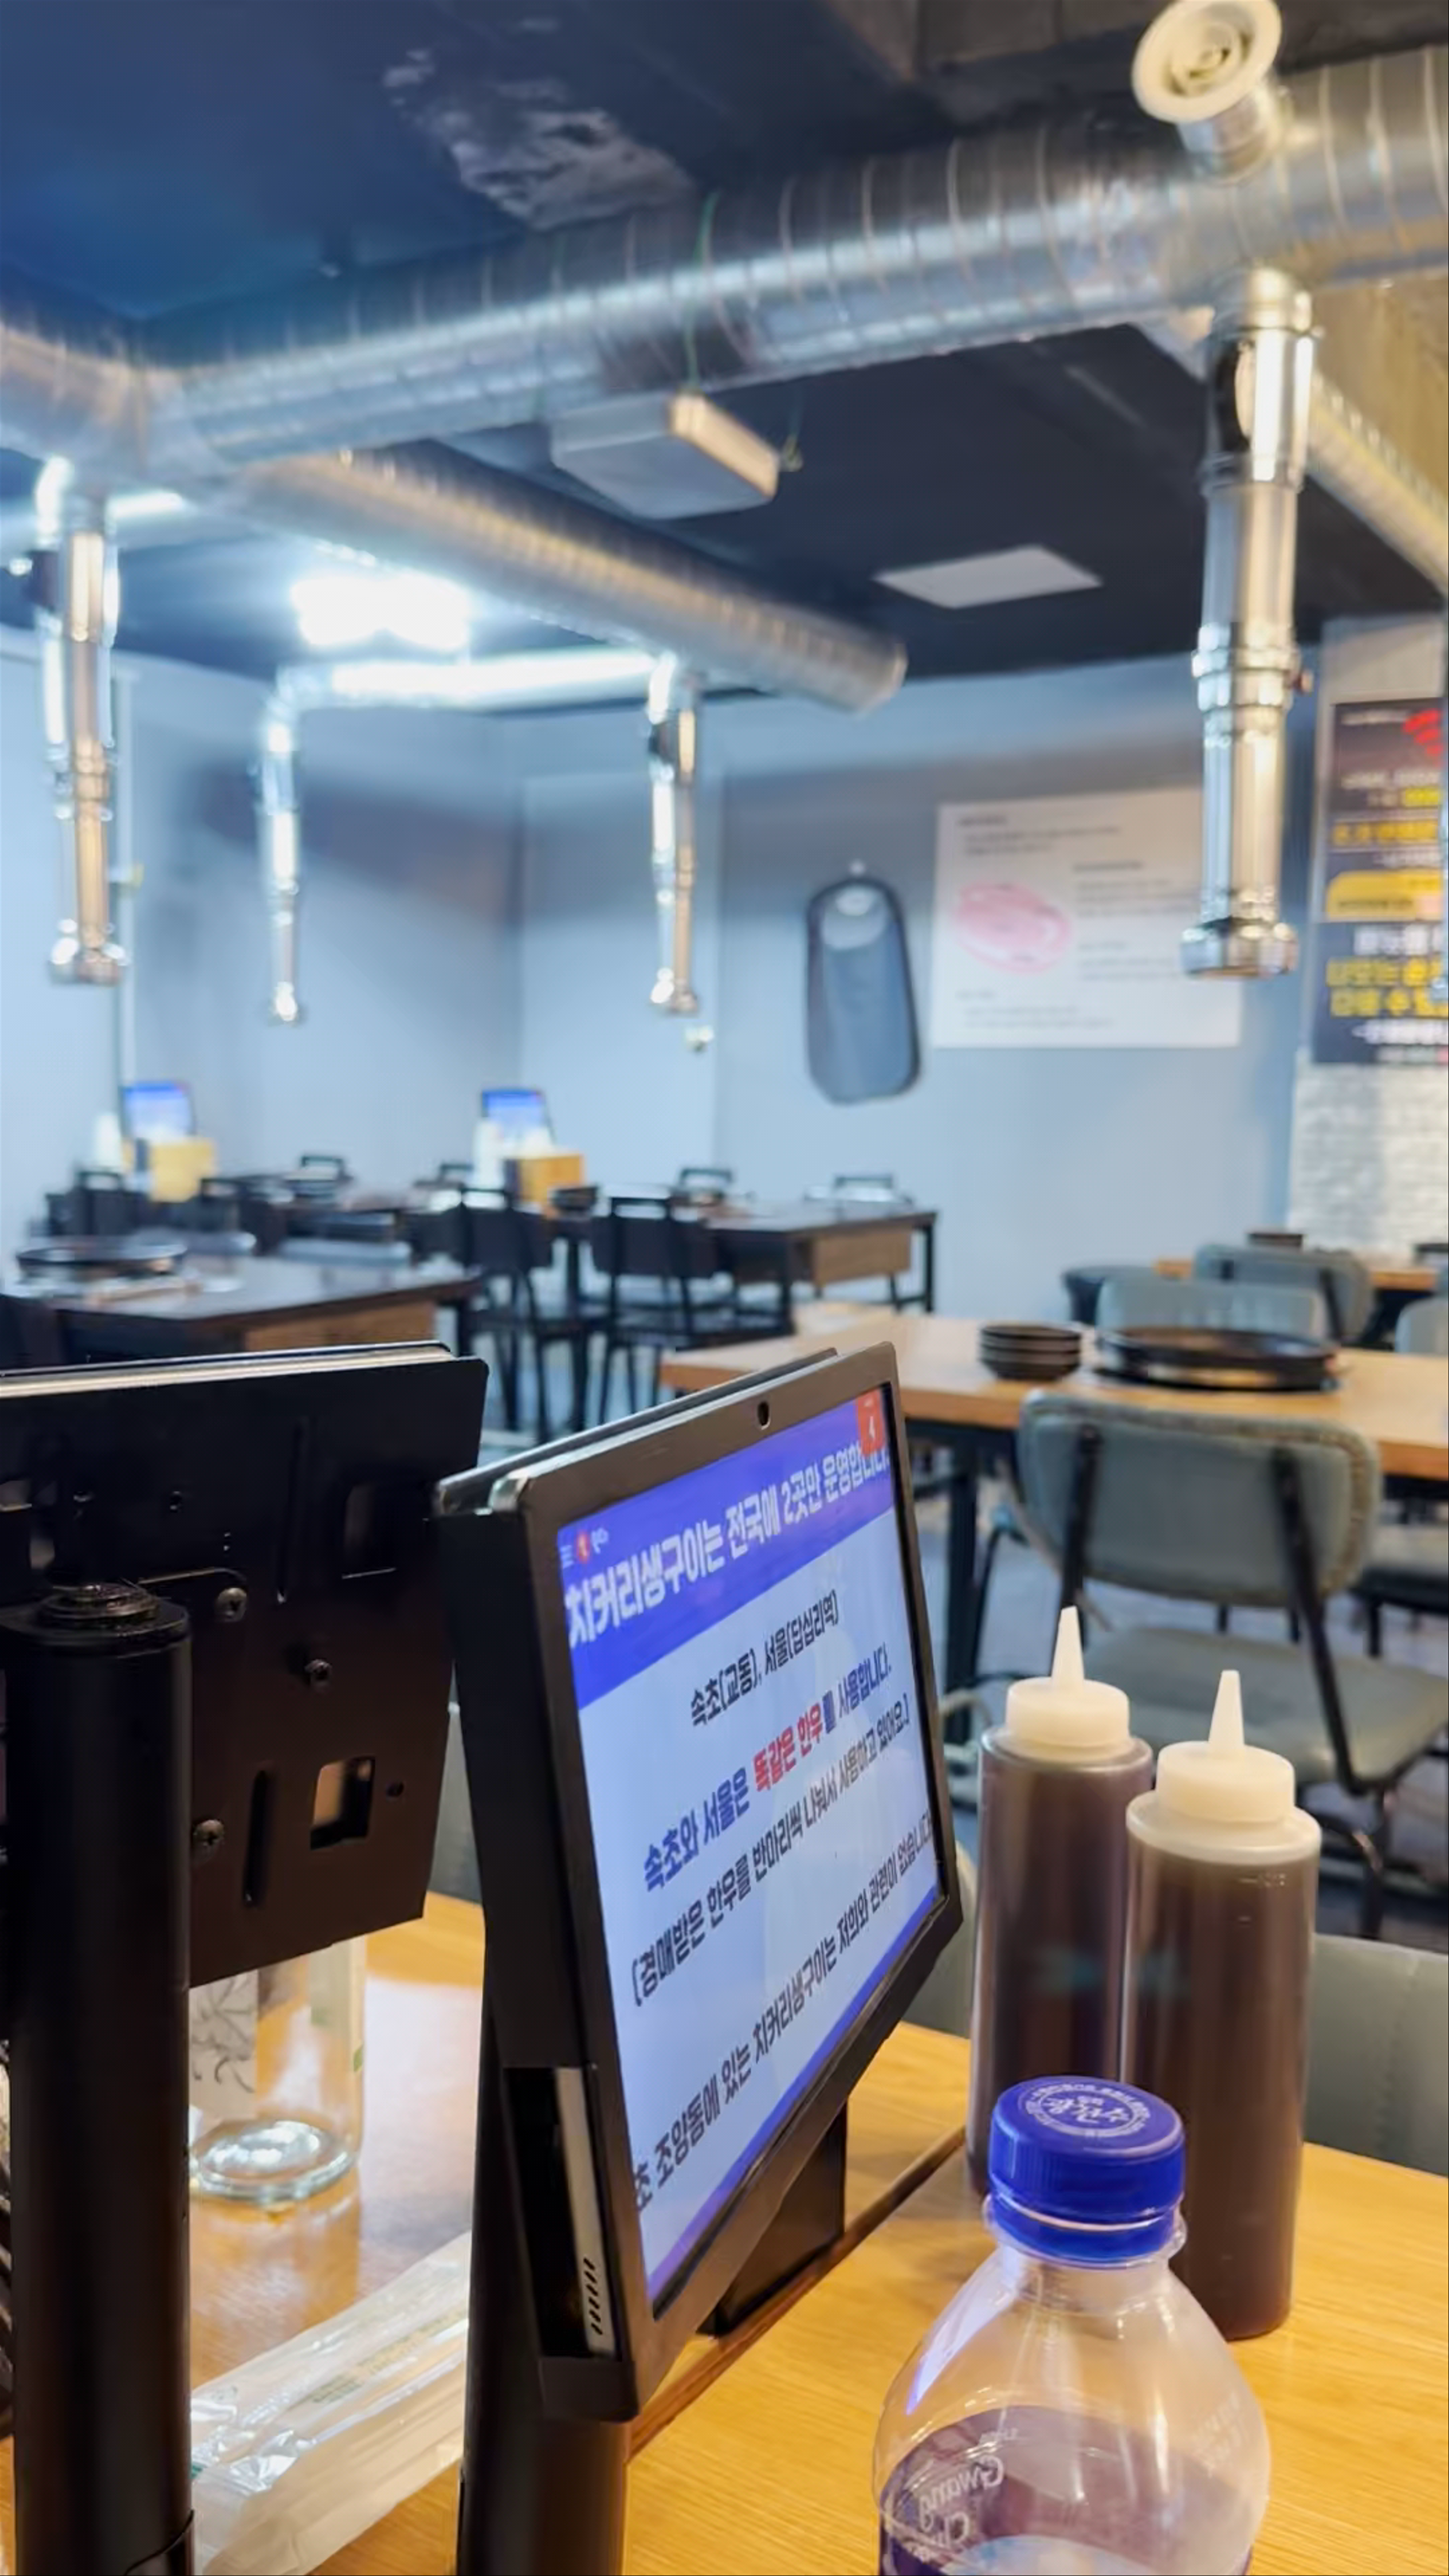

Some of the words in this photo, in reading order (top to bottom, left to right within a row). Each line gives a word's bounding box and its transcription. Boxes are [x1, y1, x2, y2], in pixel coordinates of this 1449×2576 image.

[565, 1519, 725, 1649] 치커리생구이는
[725, 1484, 781, 1559] 전국에
[781, 1462, 822, 1524] 2곳만
[691, 1648, 761, 1726] 속초(교동),
[765, 1590, 838, 1675] 서울(답십리역)
[632, 1899, 706, 2007] (경매받은
[706, 1853, 751, 1929] 한우를
[753, 1801, 803, 1882] 반마리씩
[803, 1766, 837, 1828] 나눠서
[839, 1728, 877, 1794] 사용하고
[644, 1809, 698, 1892] 속초와
[704, 1767, 749, 1845] 서울은
[754, 1726, 796, 1792] 똑같은
[838, 1644, 892, 1718] 사용합니다.
[654, 2073, 720, 2188] 조양동에
[722, 2044, 751, 2105] 있는
[752, 1935, 837, 2064] 치커리생구이는
[837, 1888, 869, 1954] 저희와
[869, 1852, 898, 1914] 관련이
